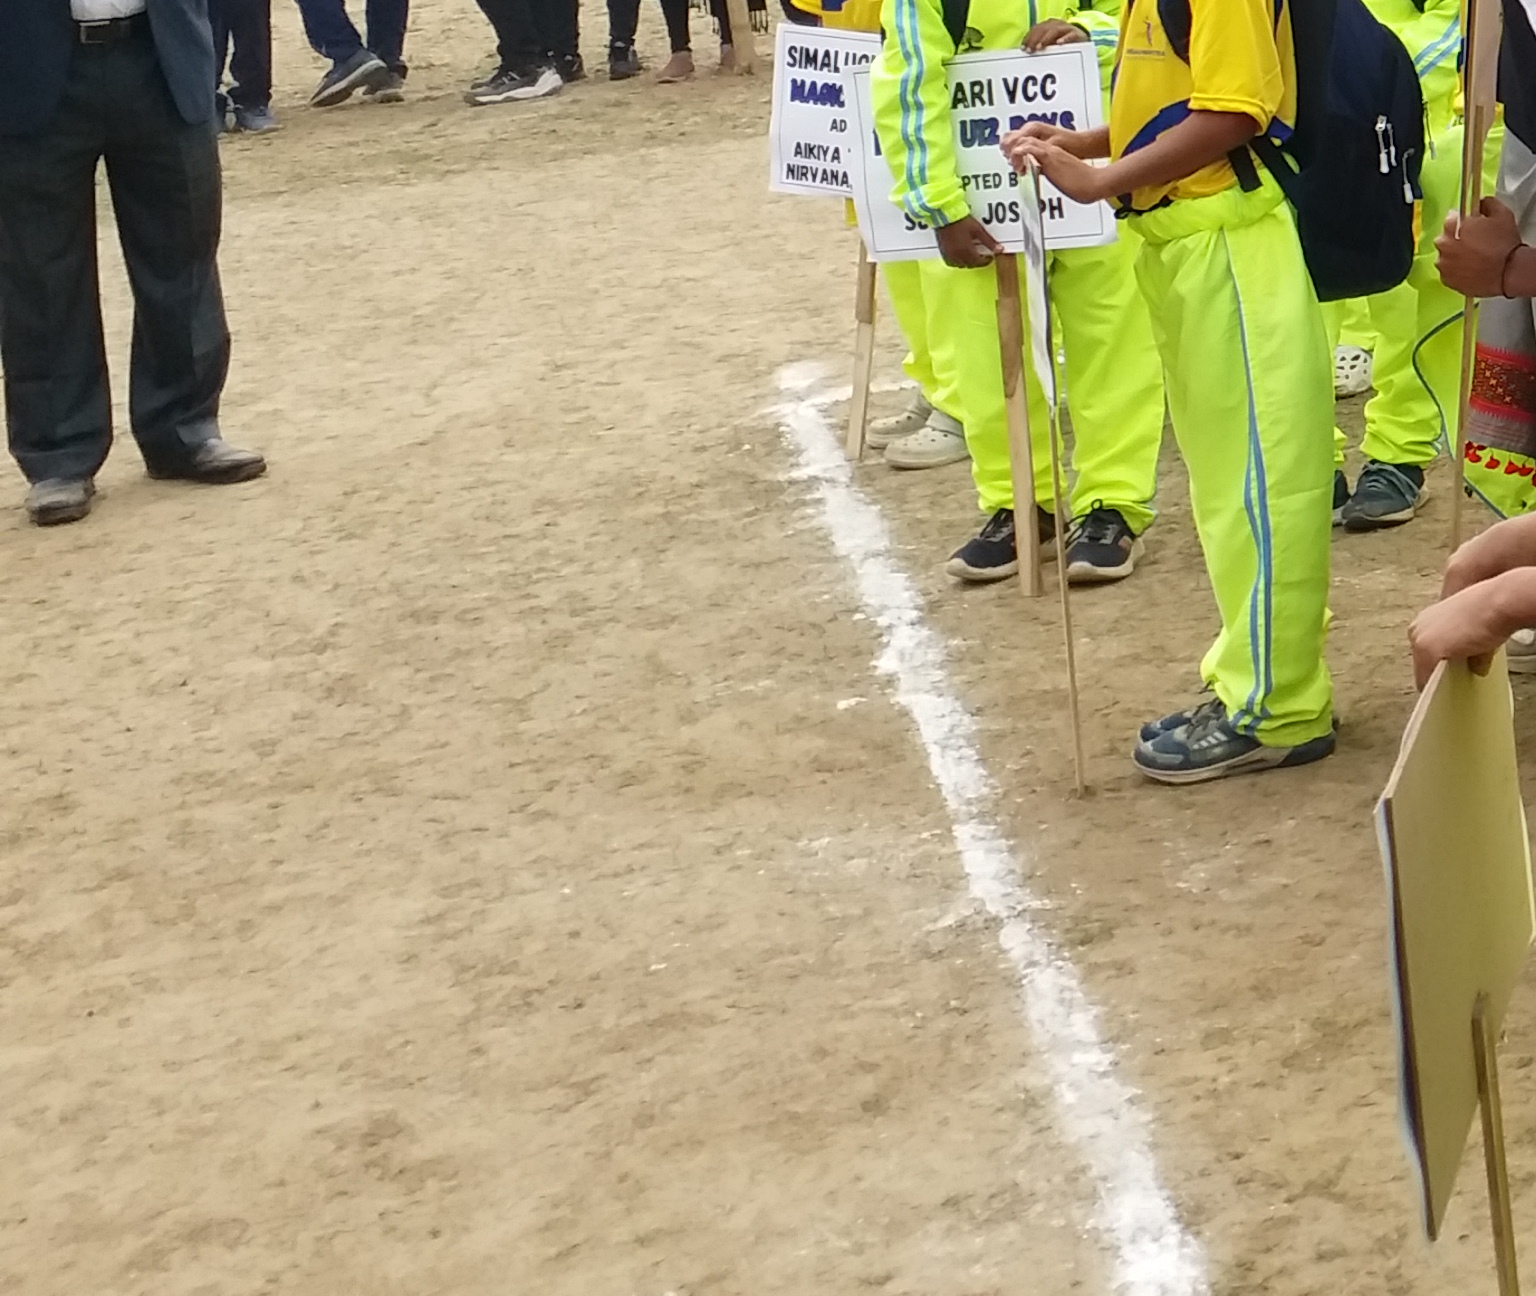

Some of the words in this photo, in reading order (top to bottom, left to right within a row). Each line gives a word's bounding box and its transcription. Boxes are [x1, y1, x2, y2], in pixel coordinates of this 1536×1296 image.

[945, 78, 995, 109] ARI
[1003, 73, 1058, 105] VCC
[794, 141, 842, 164] AIKIYA
[960, 172, 1003, 192] PTED
[1008, 171, 1020, 188] B
[981, 197, 1065, 225] JOSPH
